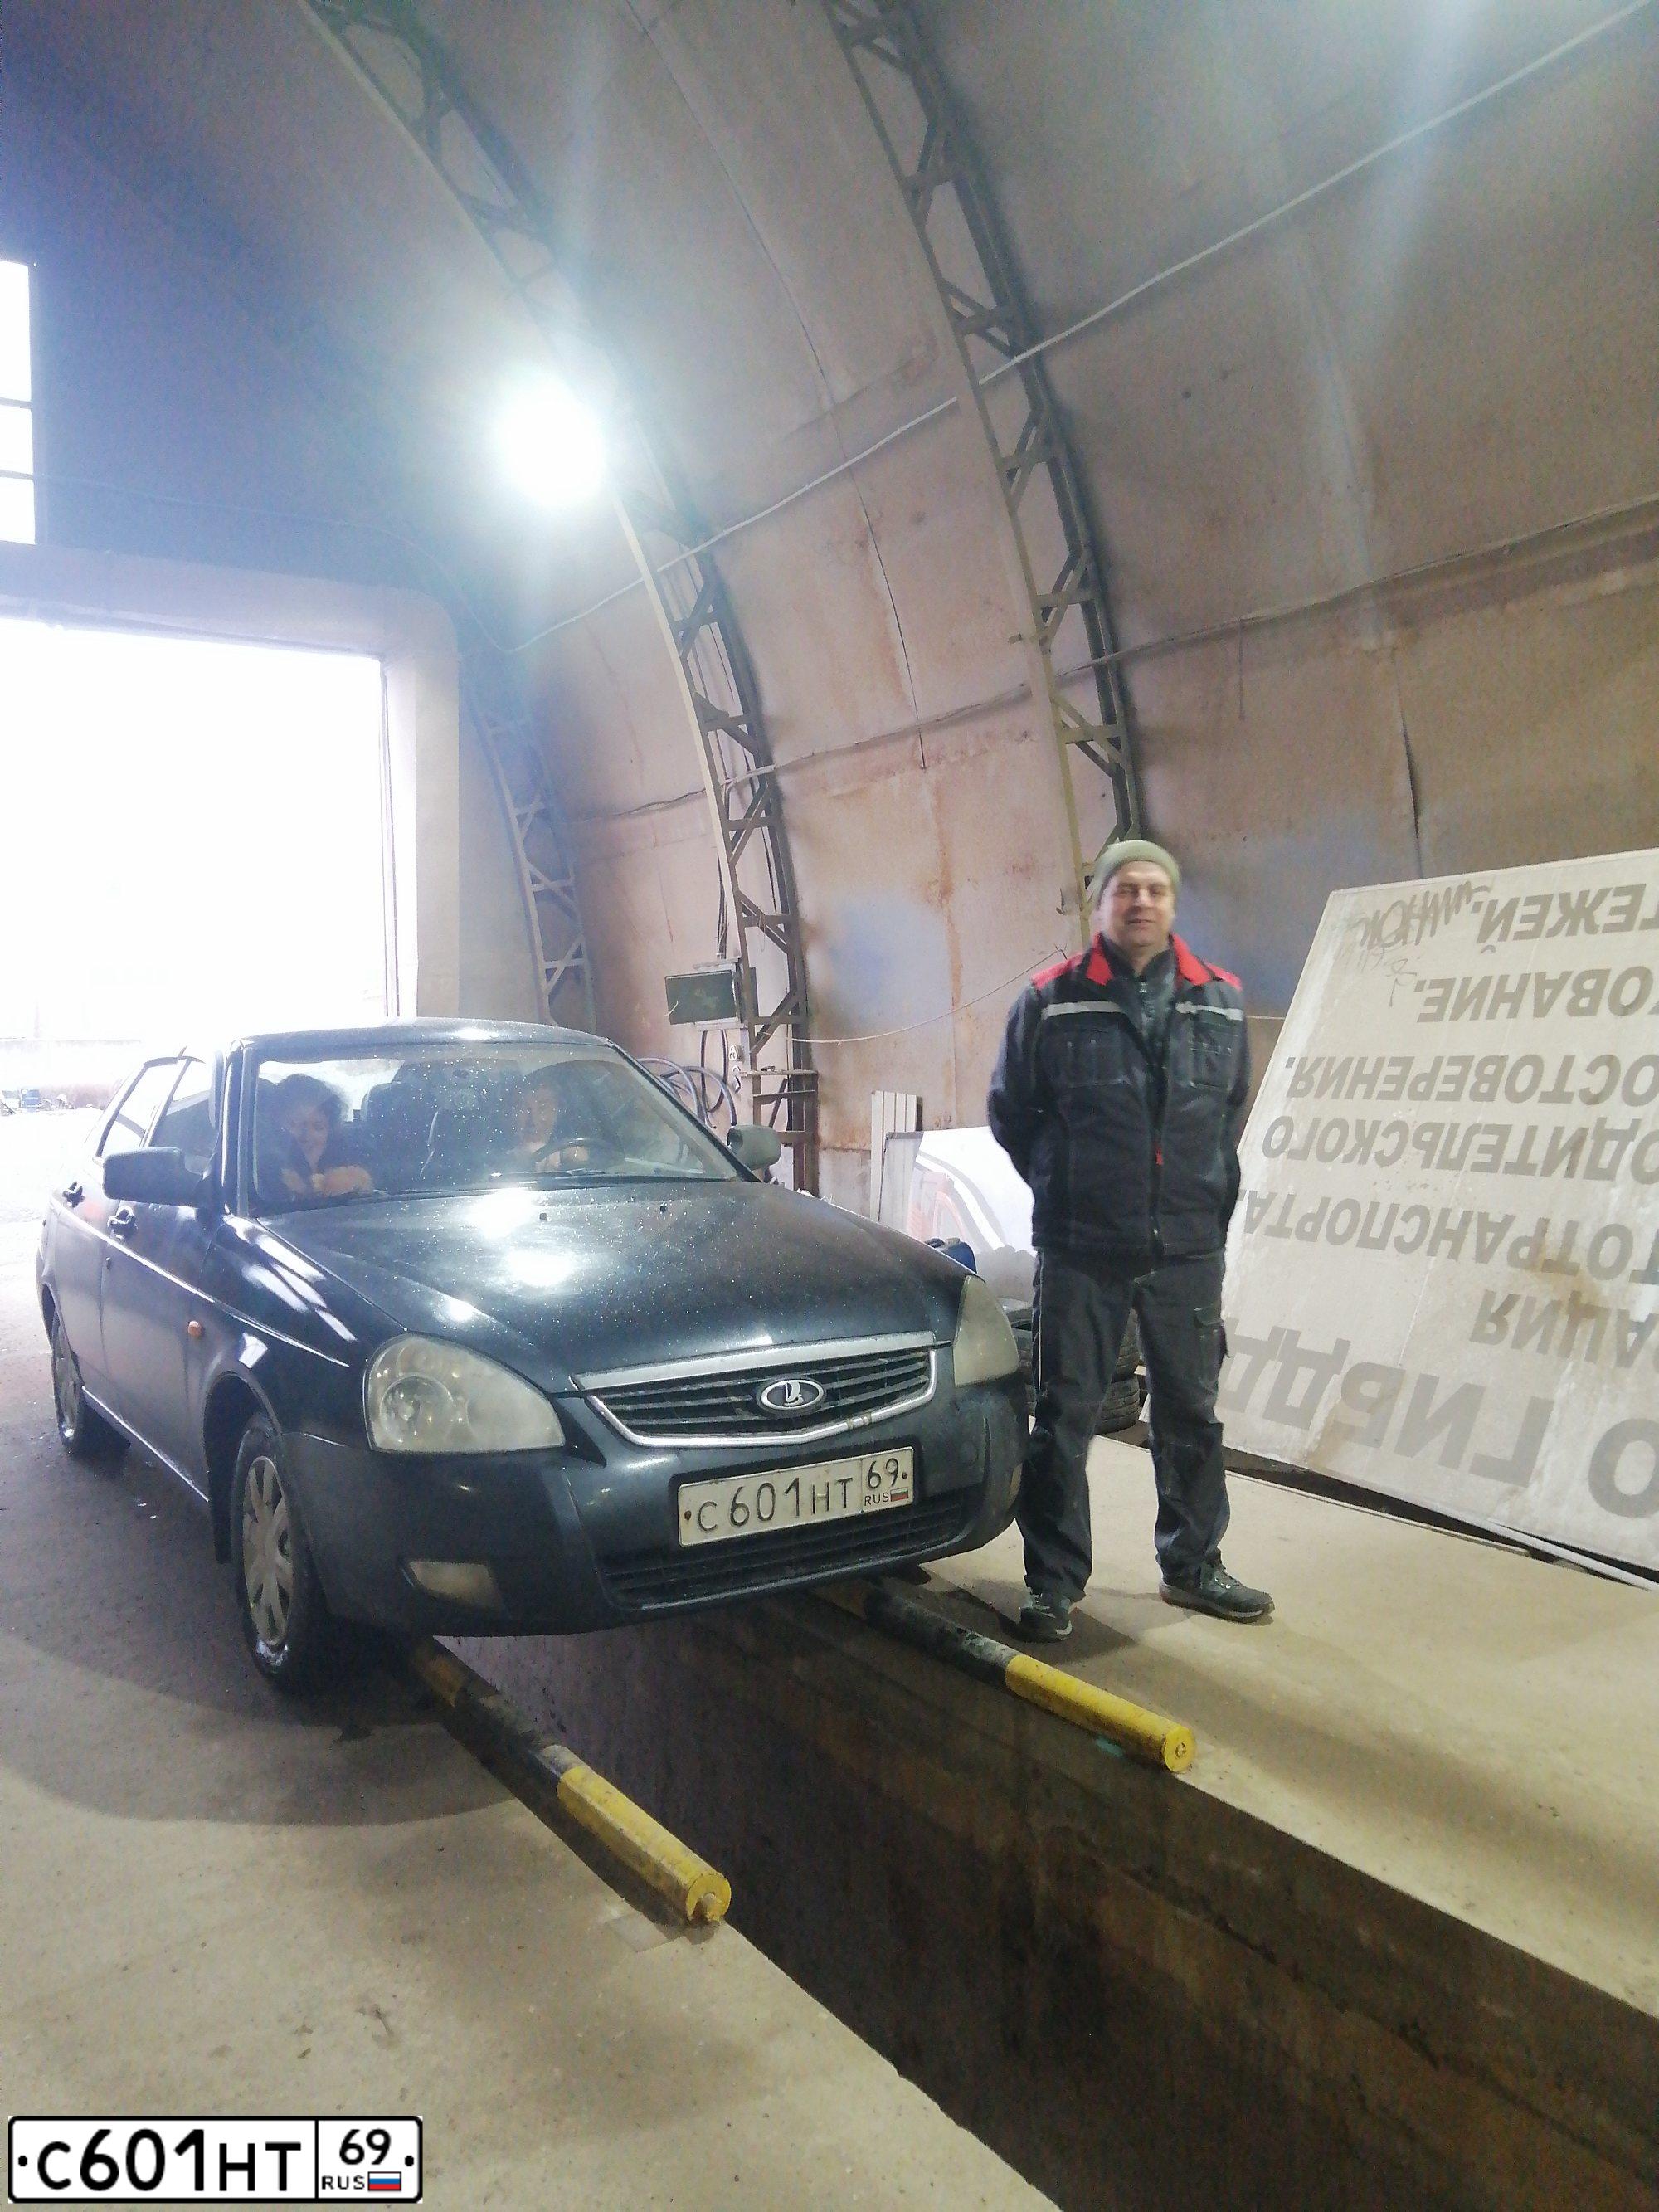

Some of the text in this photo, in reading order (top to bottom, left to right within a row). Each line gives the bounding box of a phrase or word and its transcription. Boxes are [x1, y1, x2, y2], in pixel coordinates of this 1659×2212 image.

[1413, 965, 1659, 1022] ОВАНИЕ.
[1284, 1054, 1659, 1107] ОСТОВЕРЕНИЯ.
[1262, 1115, 1659, 1185] ОДИТЕЛЬСКОГО
[1468, 1288, 1659, 1373] АЦИЯ
[1215, 1317, 1554, 1488] ГИБДД
[698, 1458, 899, 1532] С601НТ 69
[864, 1492, 889, 1506] RUS
